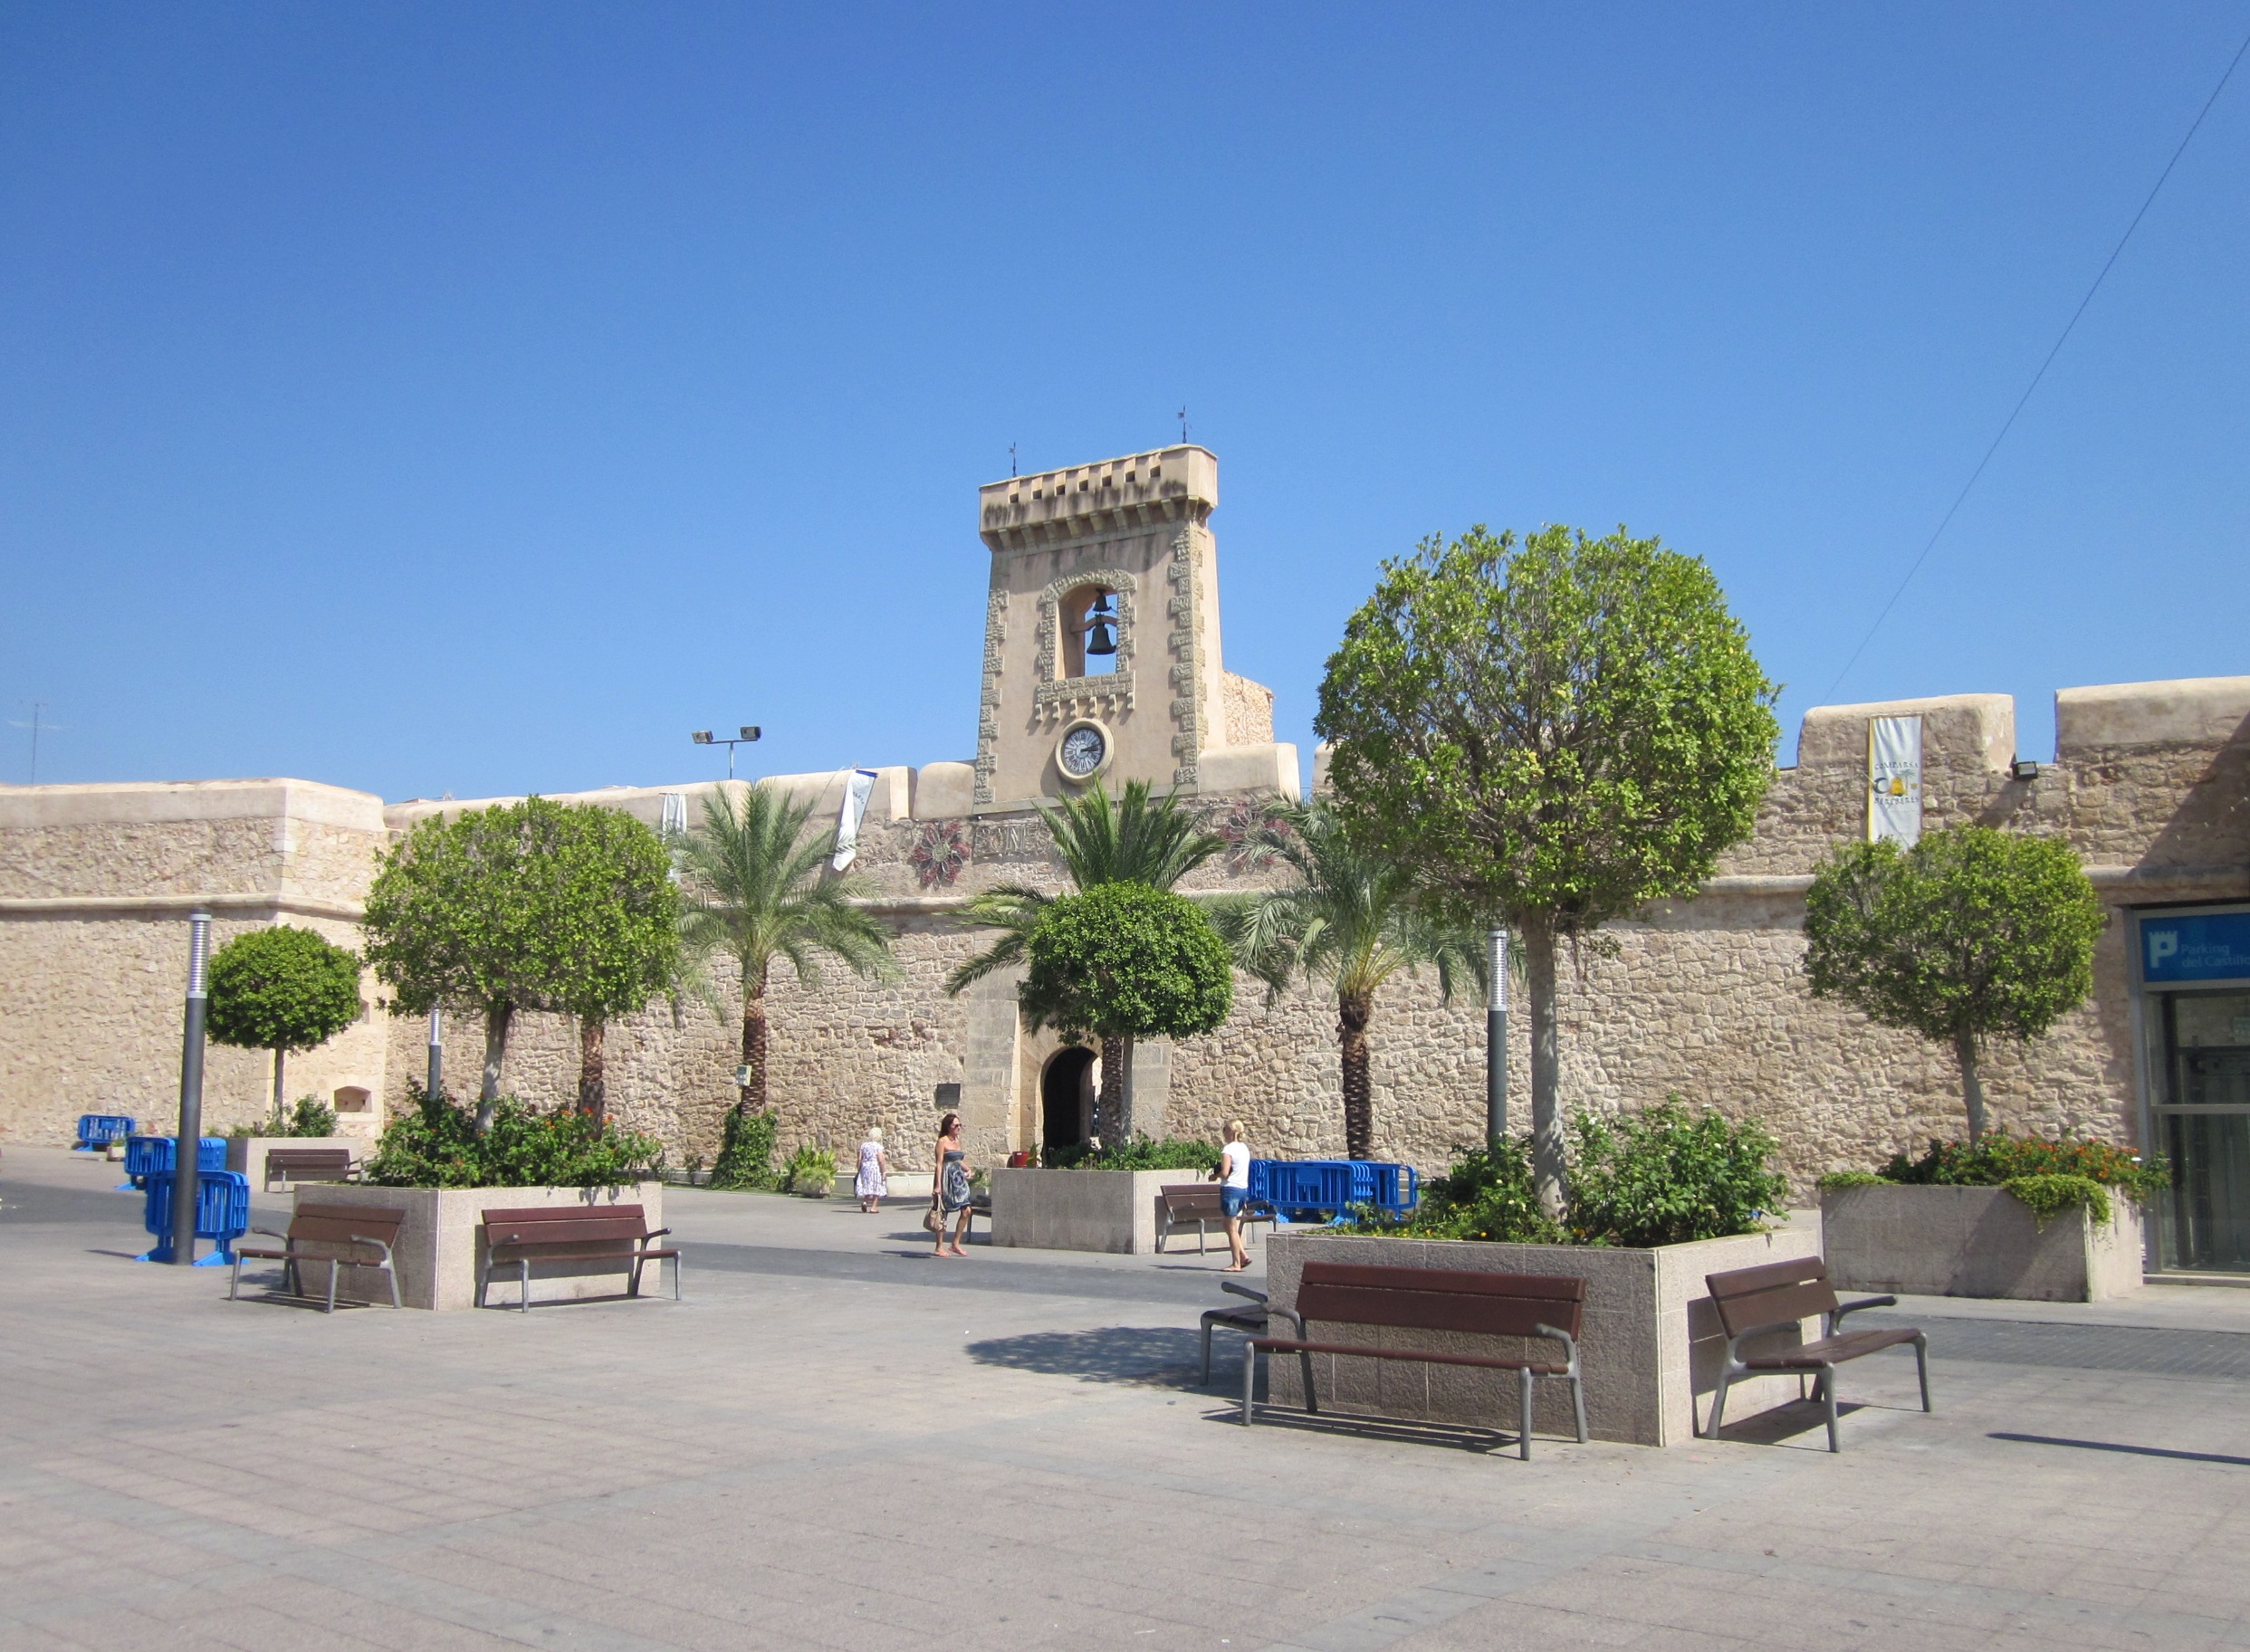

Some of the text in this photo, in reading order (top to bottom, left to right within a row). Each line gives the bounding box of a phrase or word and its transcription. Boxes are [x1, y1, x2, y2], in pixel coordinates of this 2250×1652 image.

[1874, 761, 1919, 770] COMPARSA
[2149, 931, 2178, 969] P
[2181, 943, 2229, 956] Parking
[2181, 956, 2202, 968] del
